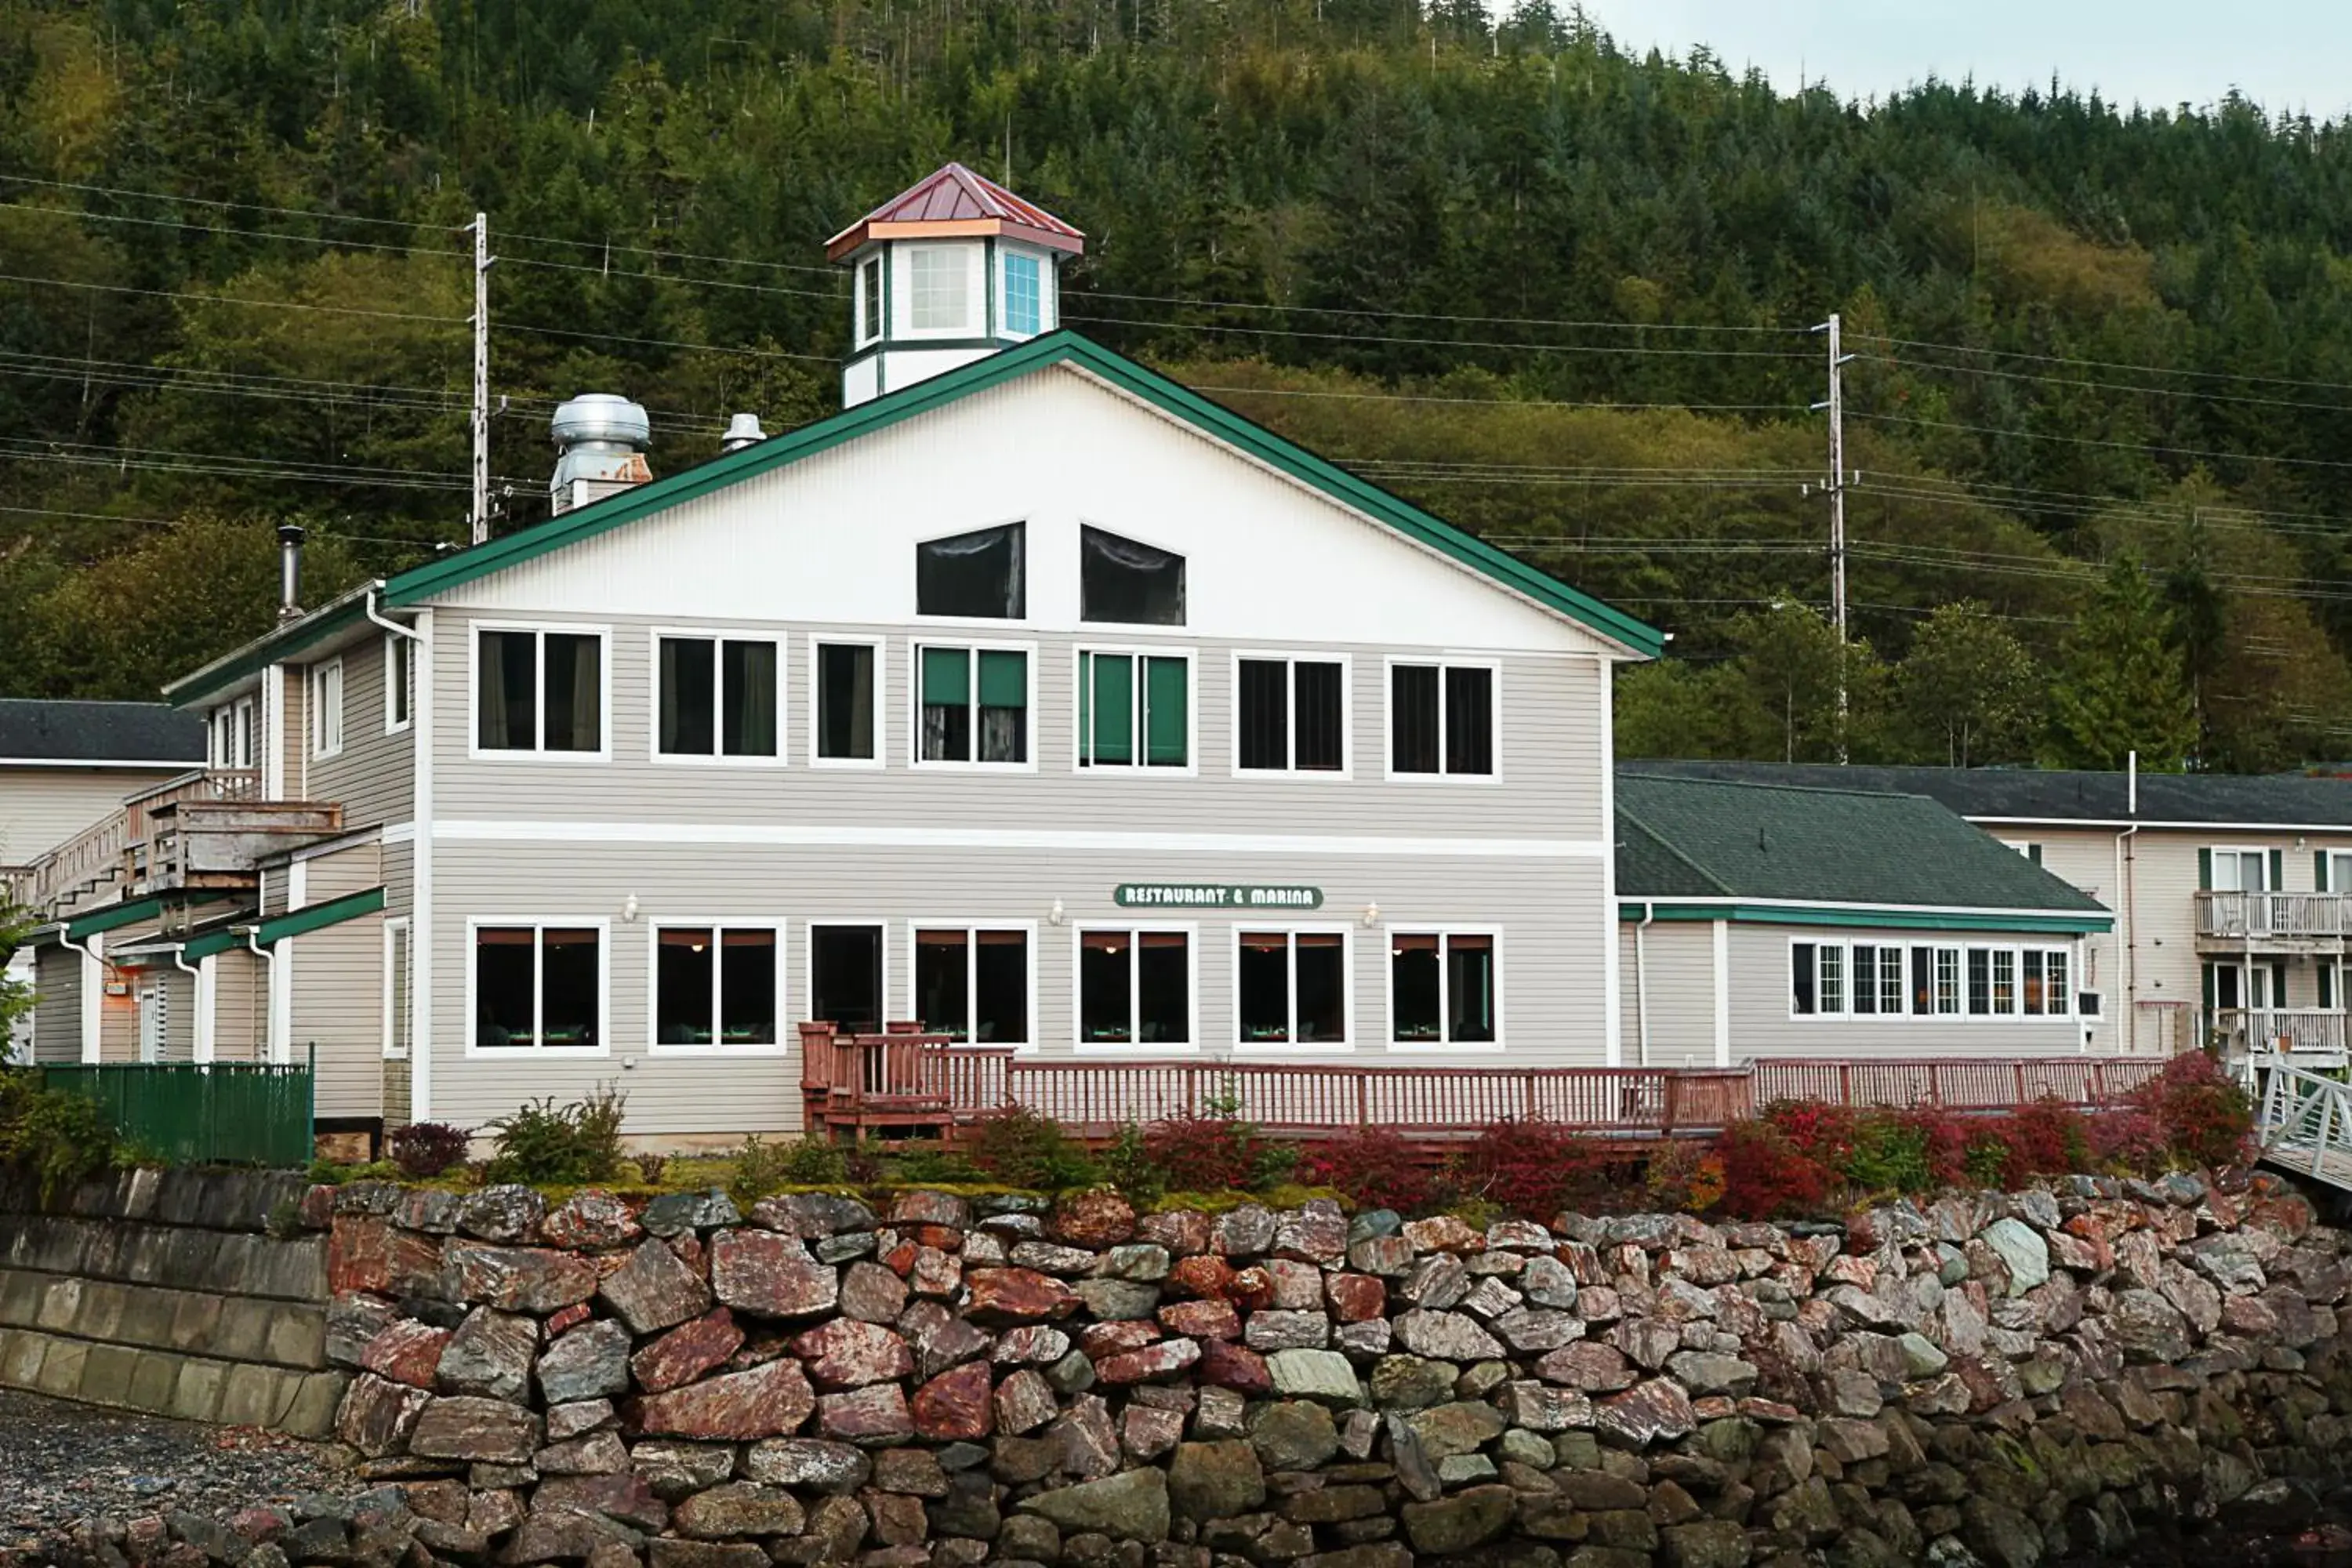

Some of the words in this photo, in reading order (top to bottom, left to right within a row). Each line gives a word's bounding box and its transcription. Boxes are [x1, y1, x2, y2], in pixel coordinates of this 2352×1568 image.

[1125, 887, 1226, 903] RESTAURANT
[1233, 888, 1243, 903] &
[1250, 889, 1313, 904] MARINA
